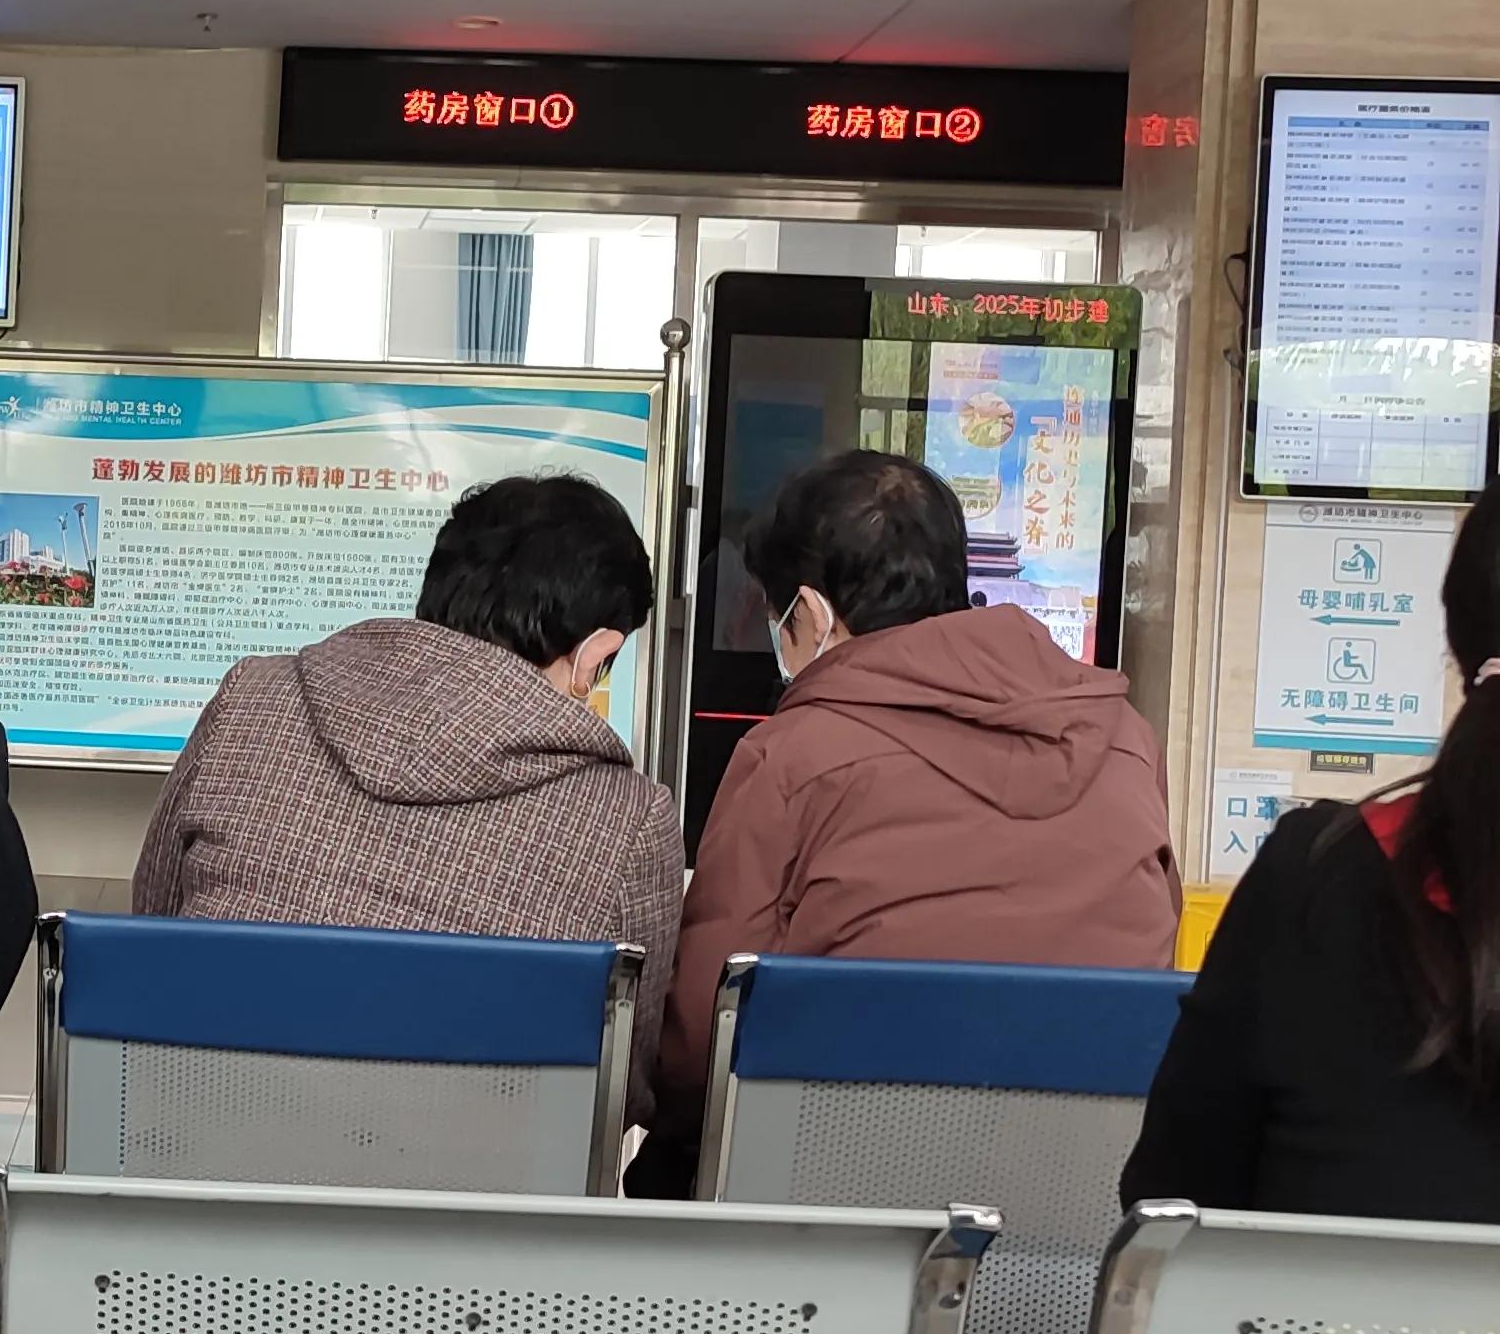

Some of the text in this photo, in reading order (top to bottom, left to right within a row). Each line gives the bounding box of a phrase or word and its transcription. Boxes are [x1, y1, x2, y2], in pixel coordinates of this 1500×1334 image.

[403, 89, 574, 130] 药房窗口①
[806, 103, 984, 145] 药房窗口②
[92, 457, 451, 493] 蓬勃发展的潍坊市精神卫生中心
[1297, 589, 1414, 614] 母婴哺乳室
[1280, 688, 1419, 715] 无障碍卫生间
